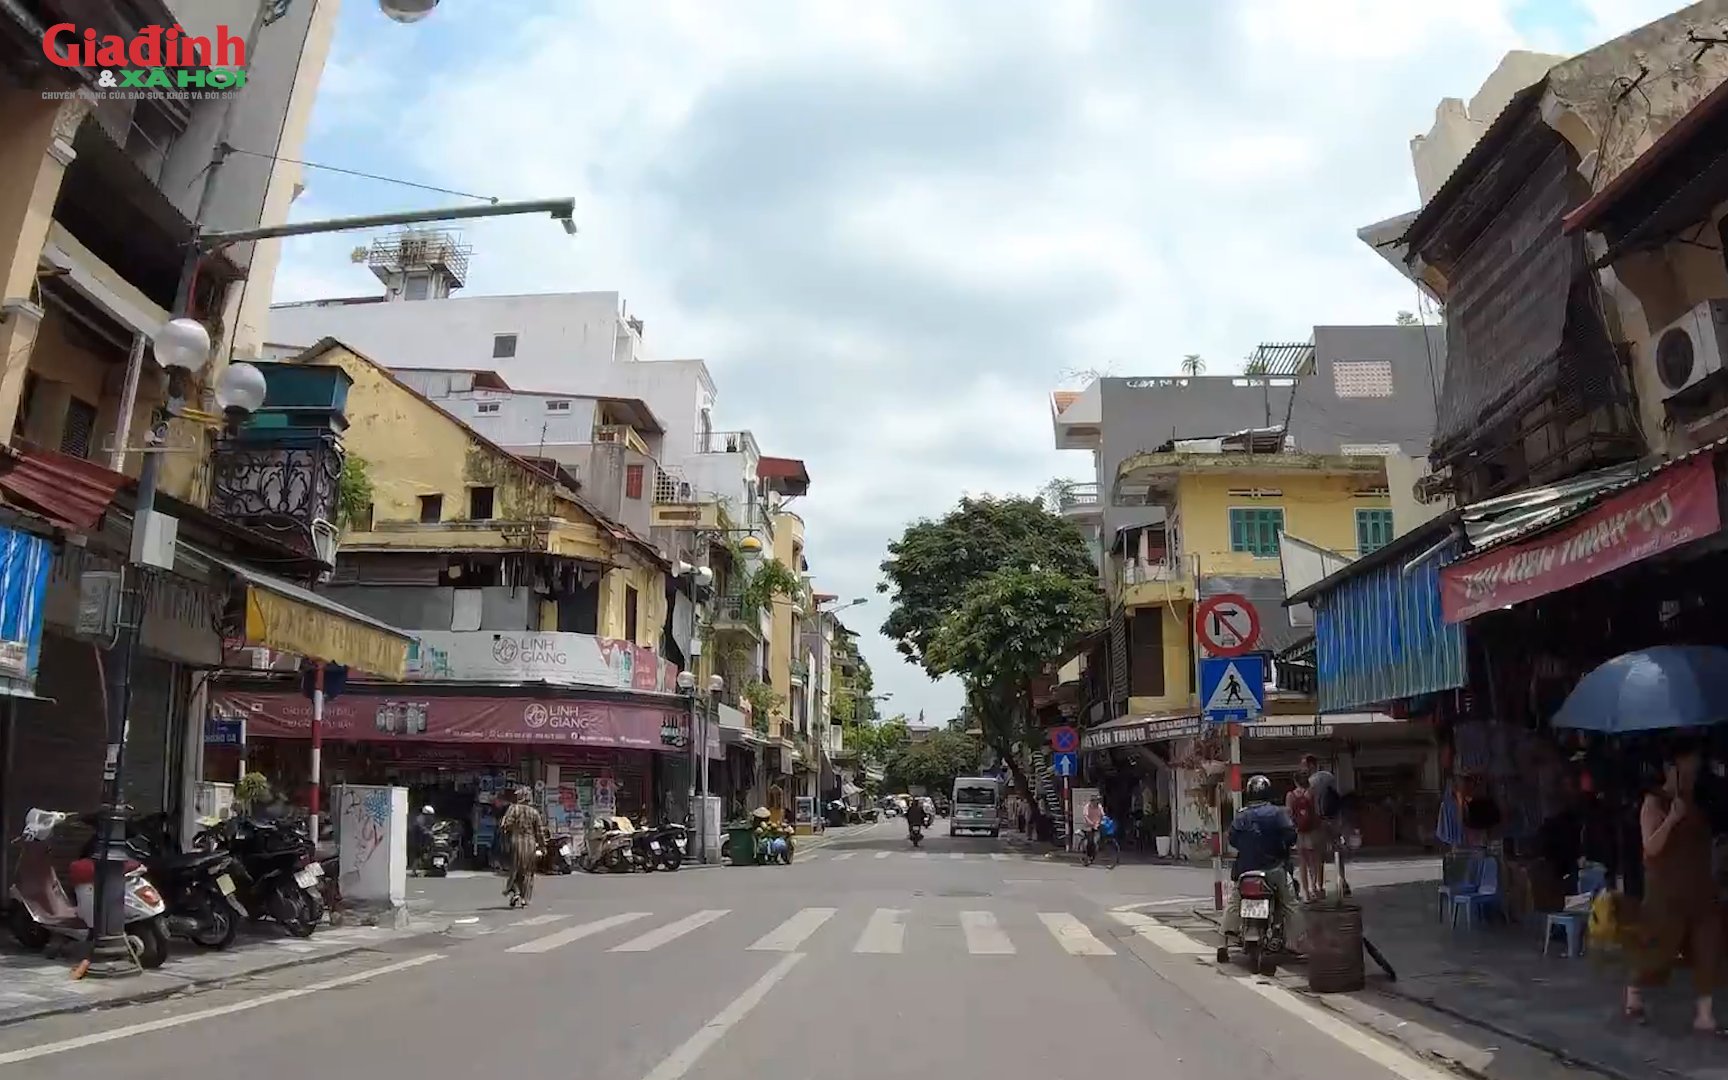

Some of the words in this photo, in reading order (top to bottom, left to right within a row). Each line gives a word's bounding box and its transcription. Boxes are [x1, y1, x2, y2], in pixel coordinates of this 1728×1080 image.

[520, 638, 555, 651] LINH
[520, 651, 567, 665] GIANG
[549, 705, 579, 716] LINH
[549, 716, 590, 728] GIANG
